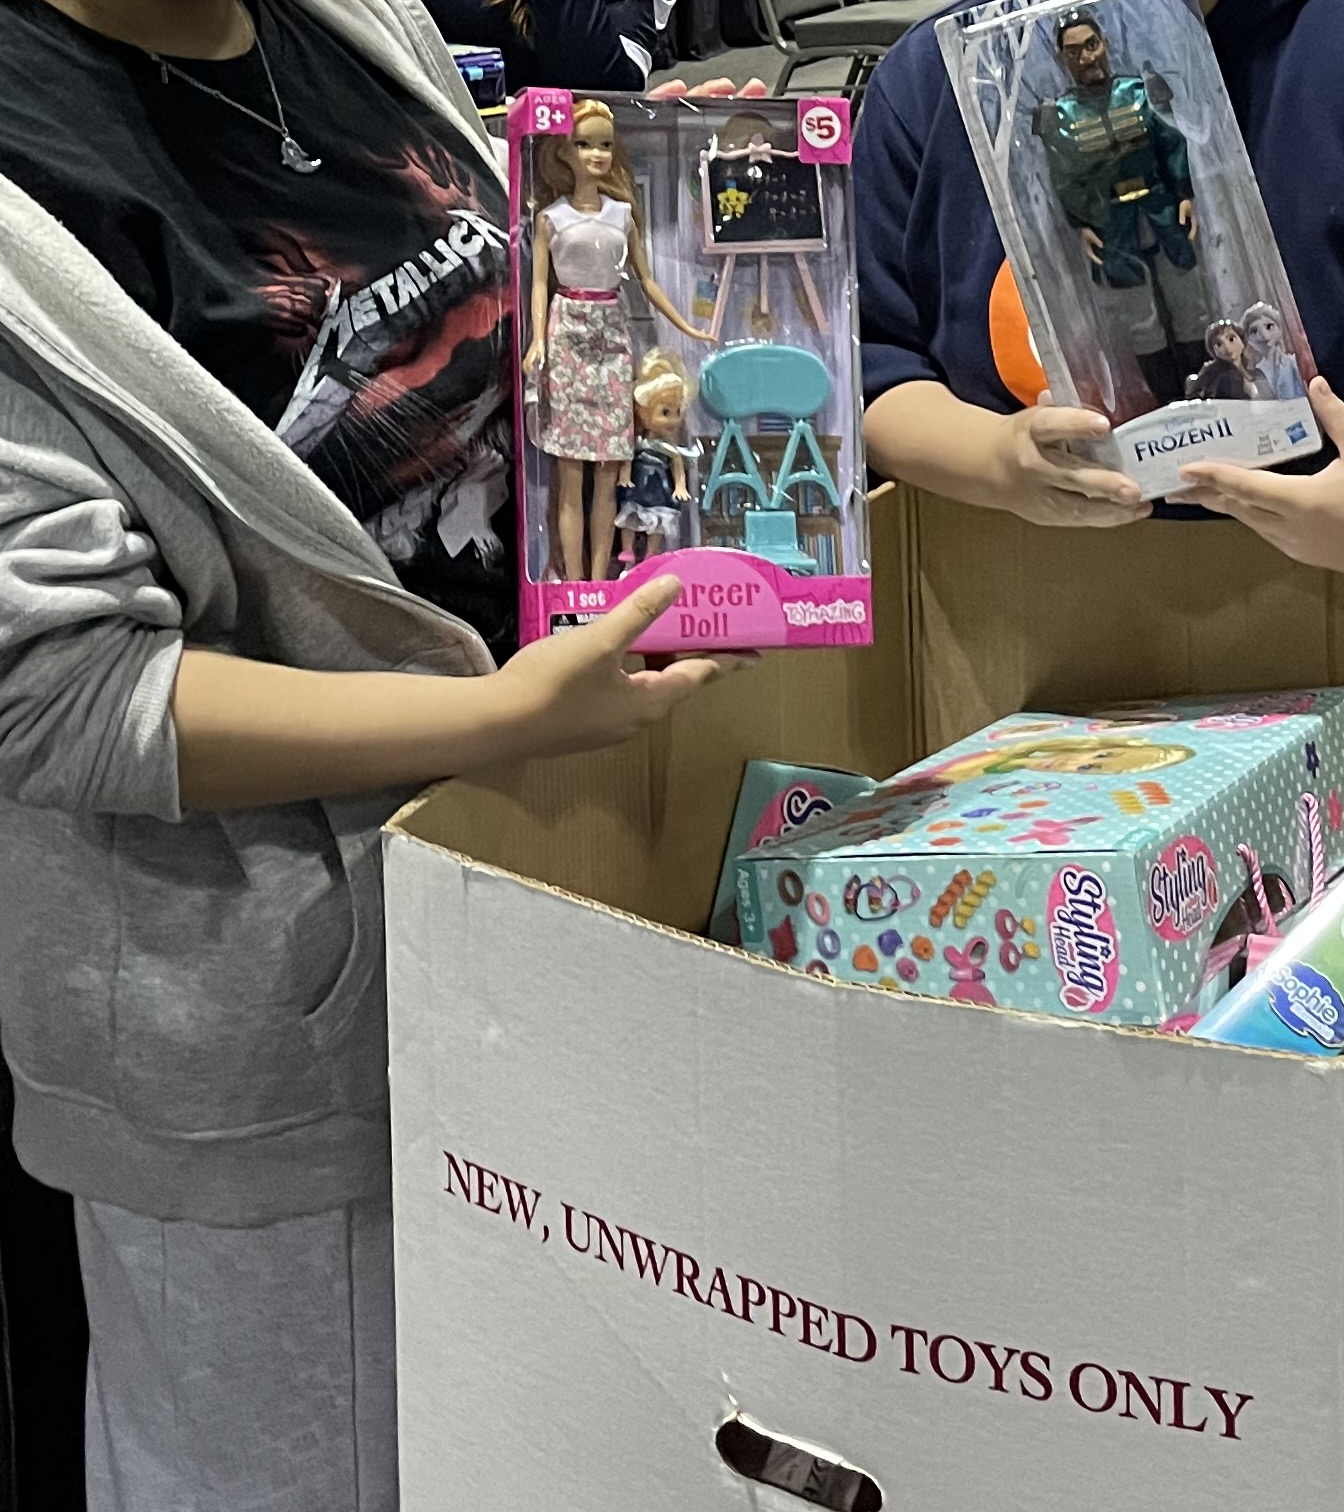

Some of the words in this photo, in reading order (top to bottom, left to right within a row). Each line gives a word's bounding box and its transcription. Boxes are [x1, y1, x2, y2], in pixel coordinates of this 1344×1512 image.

[535, 105, 567, 131] 3+
[804, 114, 837, 140] $5
[1134, 425, 1214, 462] FROZEN
[1215, 417, 1233, 438] II
[567, 590, 575, 608] 1
[579, 590, 607, 608] set
[679, 612, 729, 638] Doll
[737, 868, 751, 908] Ages
[1150, 846, 1207, 928] Styling
[1052, 924, 1076, 968] Head
[1055, 870, 1112, 998] Styling
[1270, 967, 1337, 1024] Sophie
[442, 1149, 551, 1244] NEW,
[560, 1202, 878, 1364] UNWRAPPED
[889, 1323, 1054, 1403] TOYS
[1068, 1361, 1254, 1441] ONLY
